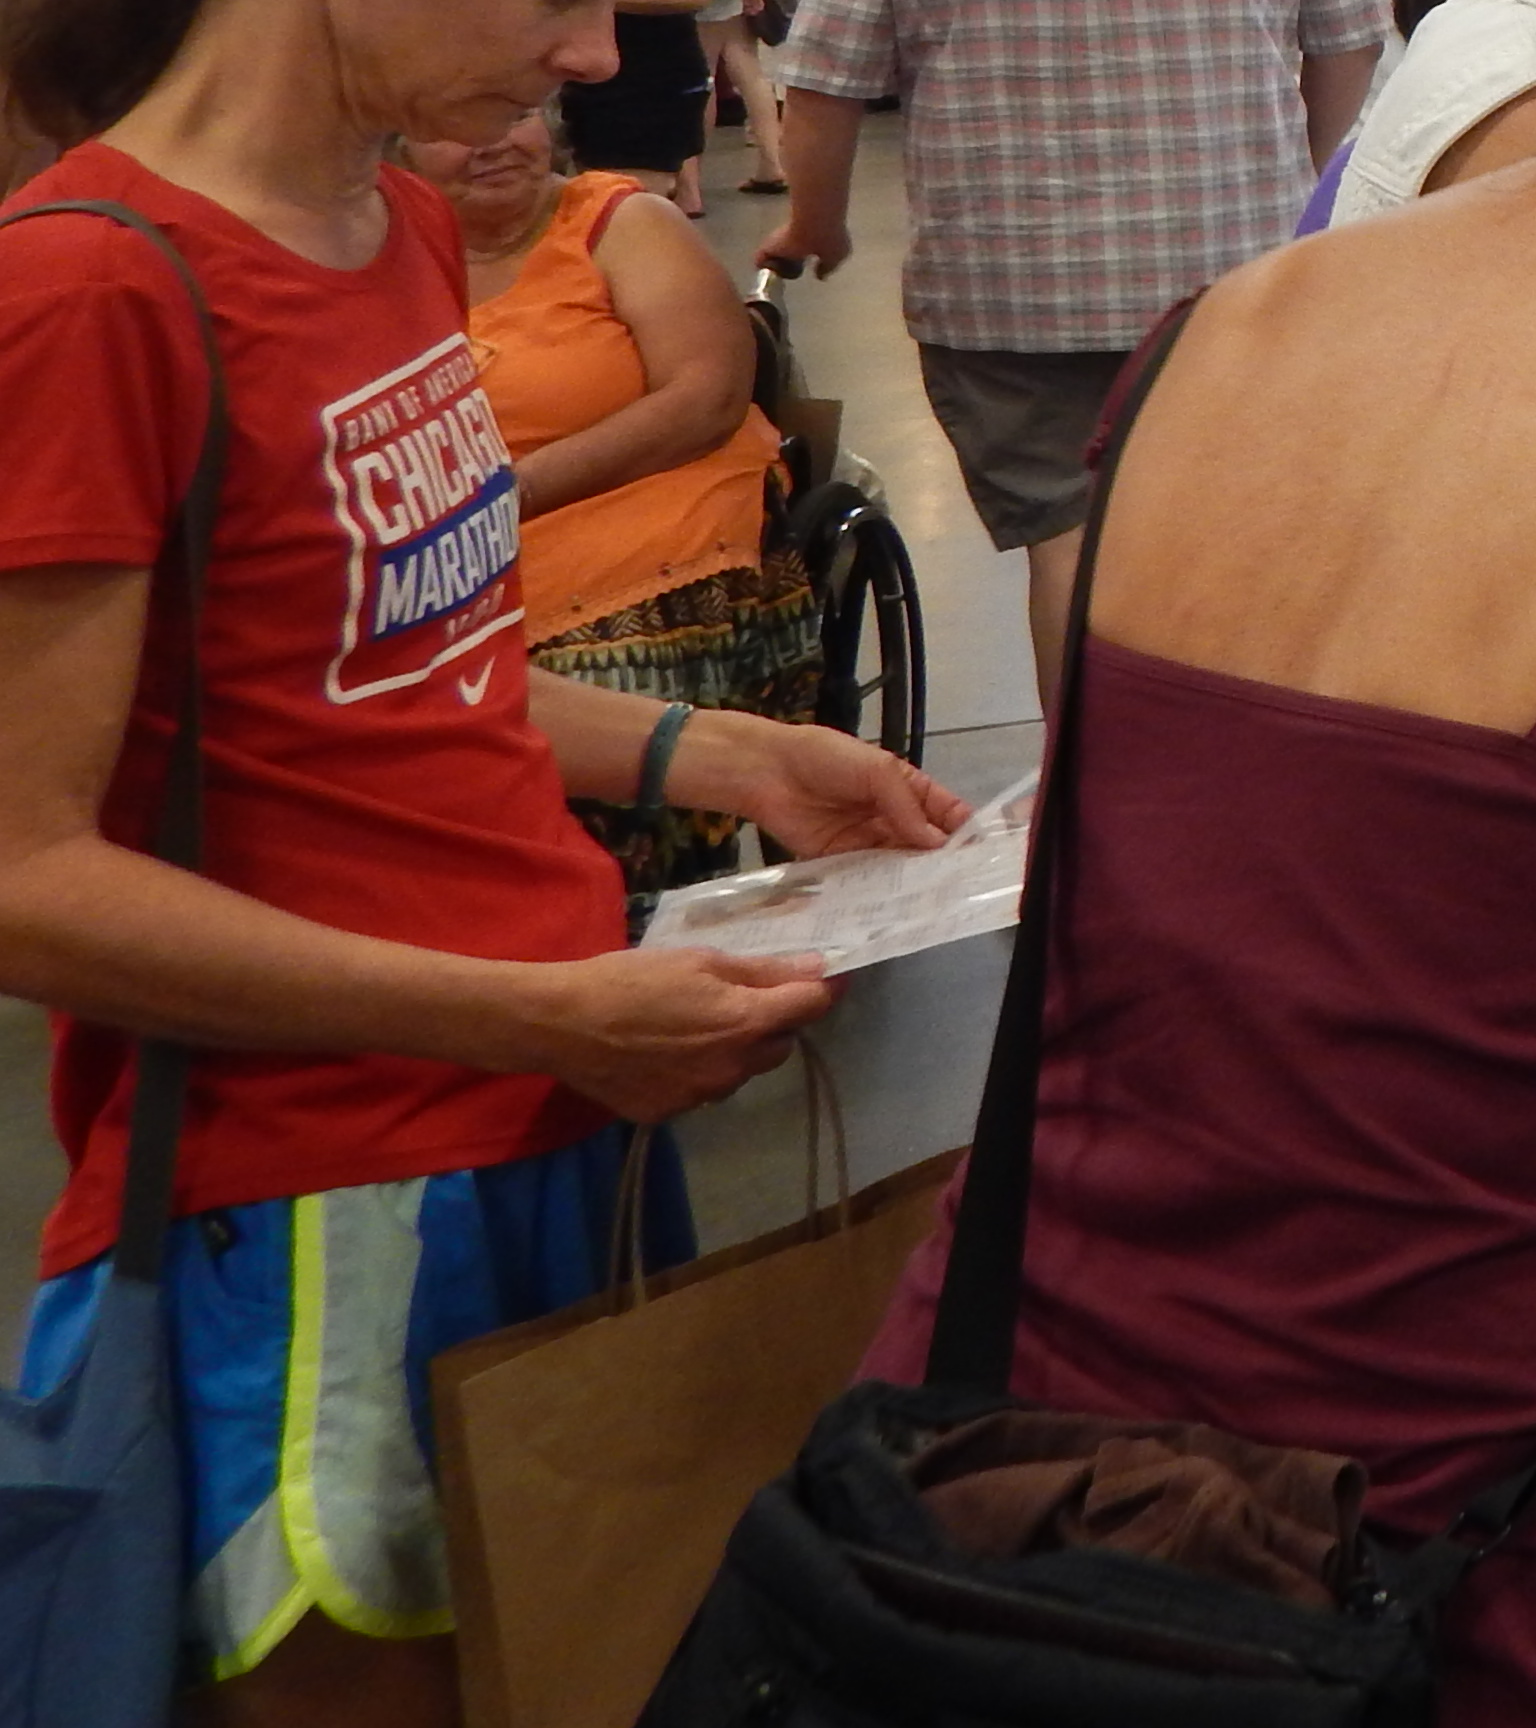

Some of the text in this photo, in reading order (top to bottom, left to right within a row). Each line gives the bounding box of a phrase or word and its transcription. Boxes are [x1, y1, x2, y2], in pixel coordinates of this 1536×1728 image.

[344, 400, 400, 452] BANK
[397, 385, 425, 421] OF
[352, 386, 513, 546] CHICAGO
[373, 484, 521, 637] MARATHO
